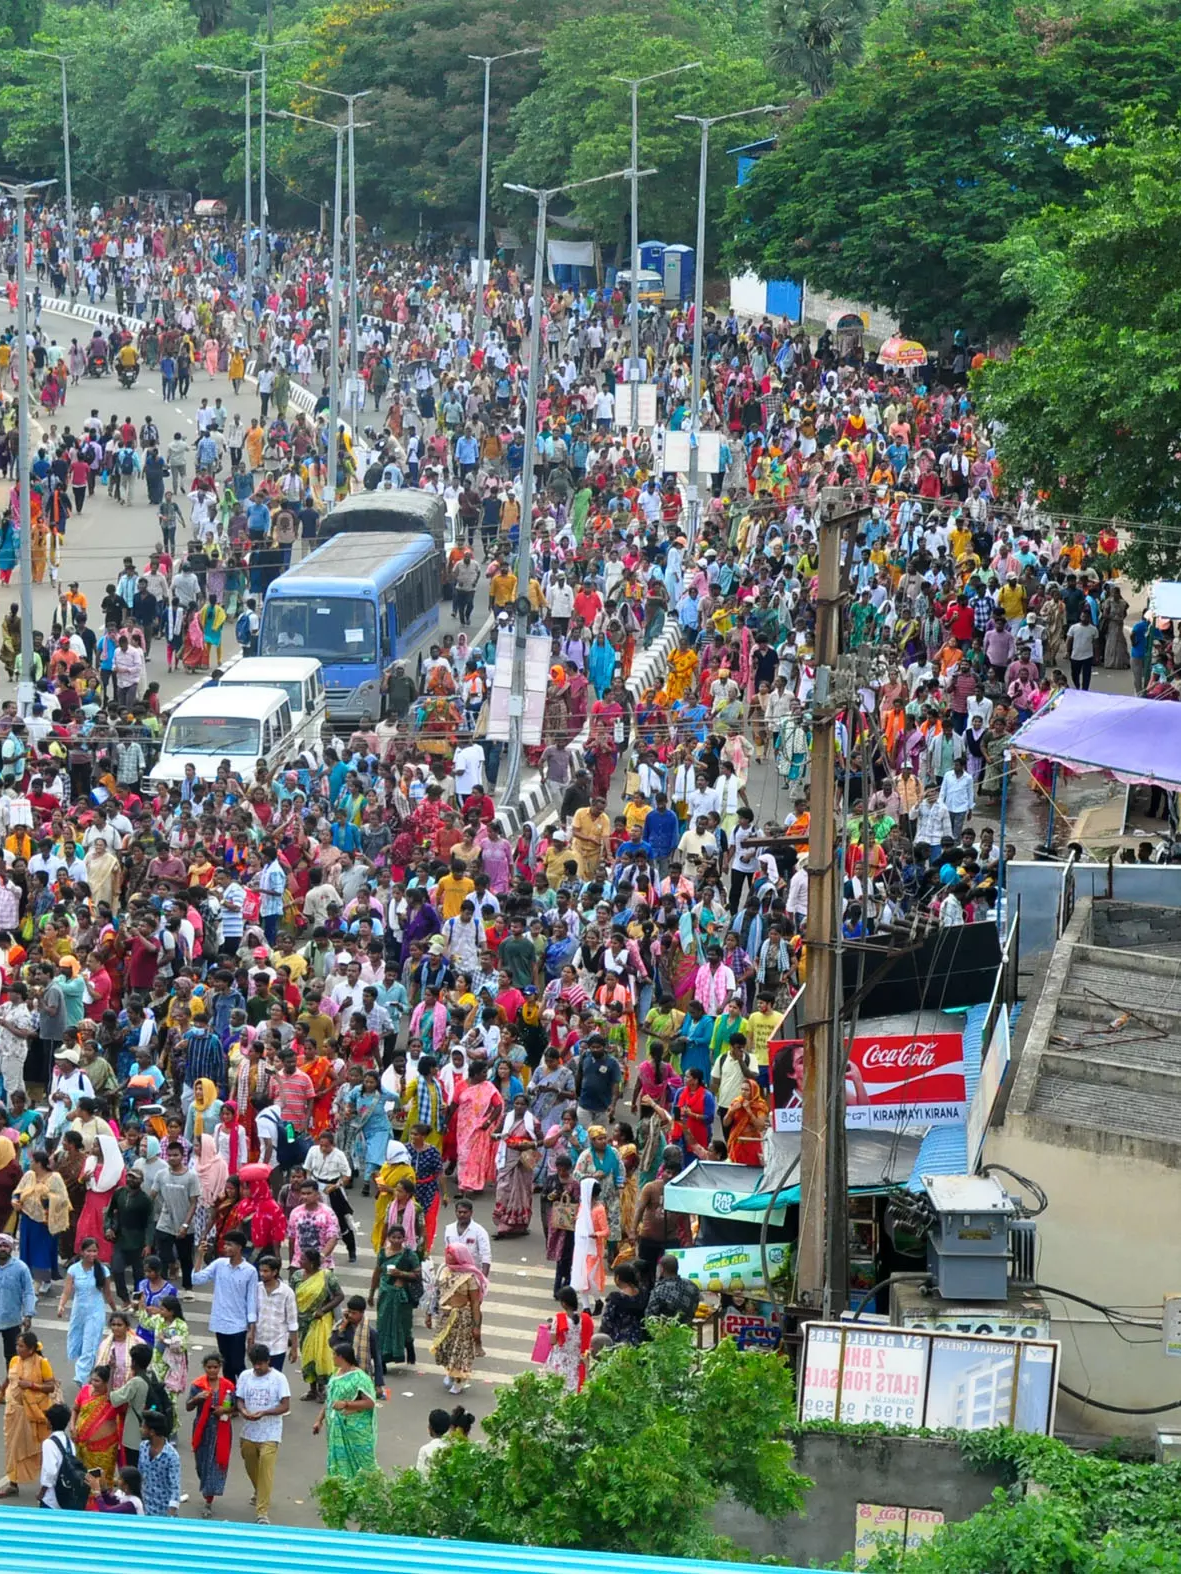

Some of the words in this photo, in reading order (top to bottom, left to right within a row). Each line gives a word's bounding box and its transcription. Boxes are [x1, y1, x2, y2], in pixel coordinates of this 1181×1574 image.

[862, 1042, 939, 1069] Coca-Cola
[873, 1108, 923, 1121] KIRANMAYI
[925, 1107, 959, 1119] KIRANA
